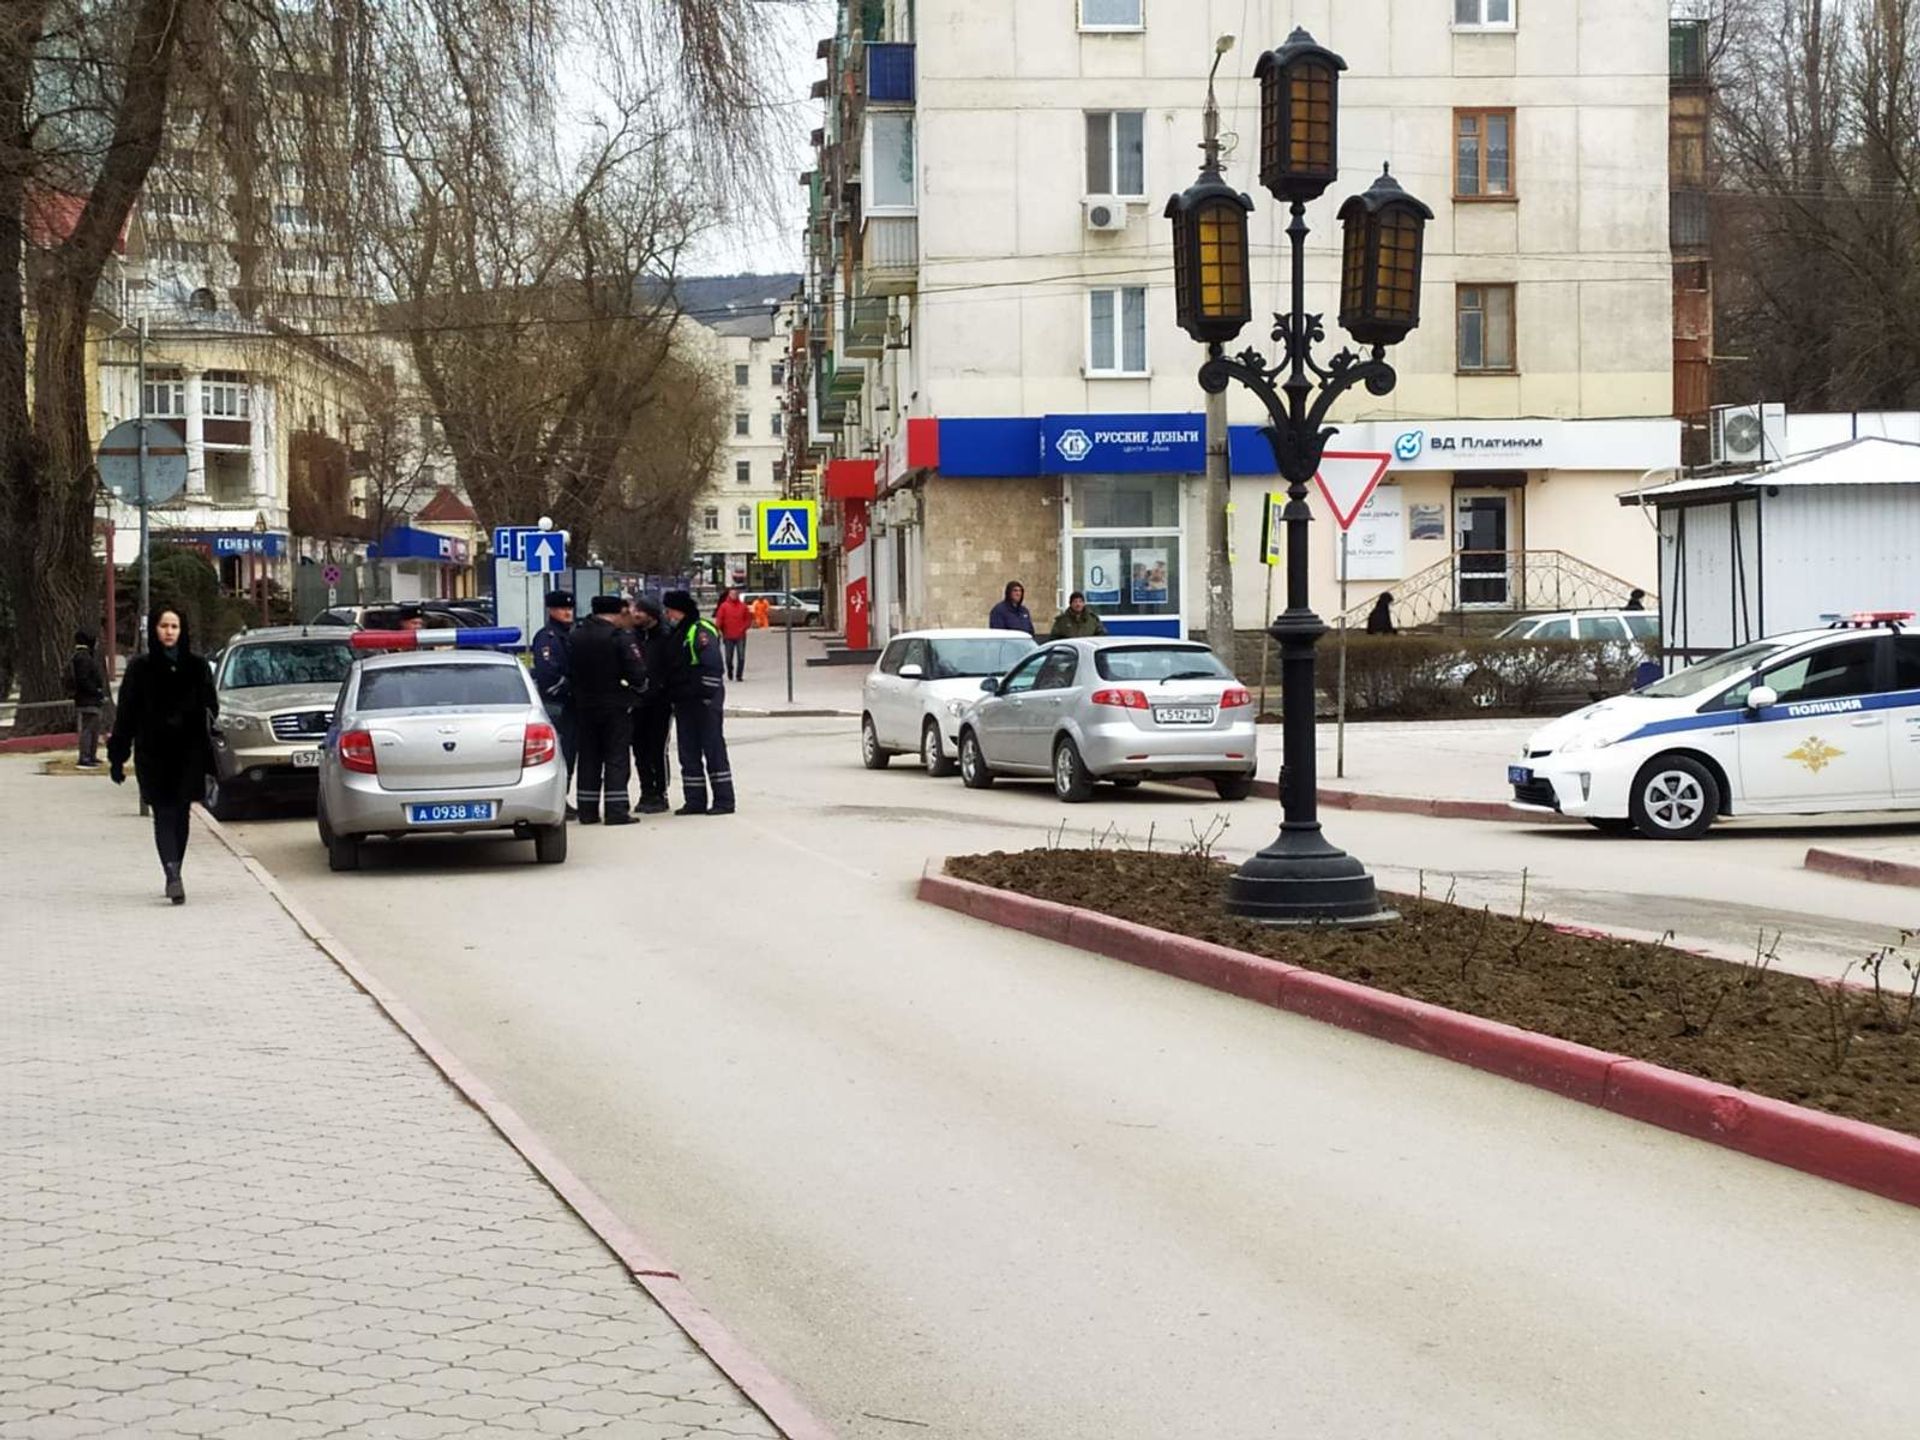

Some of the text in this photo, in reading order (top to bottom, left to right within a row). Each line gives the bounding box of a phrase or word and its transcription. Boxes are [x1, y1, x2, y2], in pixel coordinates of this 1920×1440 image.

[1094, 431, 1199, 444] РУССКИЕ ДЕНЬГИ
[1430, 437, 1456, 450] ВД
[1788, 699, 1863, 716] ПОЛИЦИЯ
